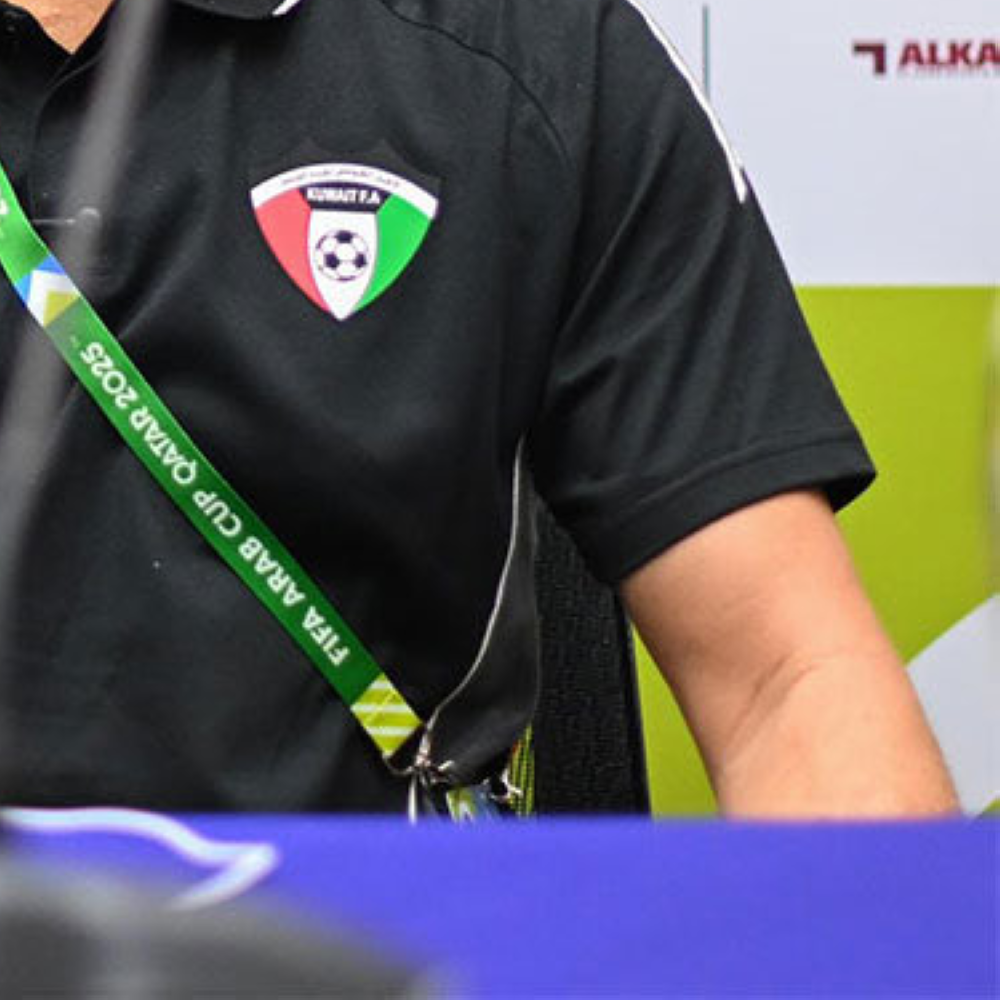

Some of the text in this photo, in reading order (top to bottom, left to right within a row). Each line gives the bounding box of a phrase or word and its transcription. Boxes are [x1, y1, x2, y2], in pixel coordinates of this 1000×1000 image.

[899, 41, 1000, 72] ALKA
[80, 340, 350, 667] FIFA ARAB CUP QATAR 2025
